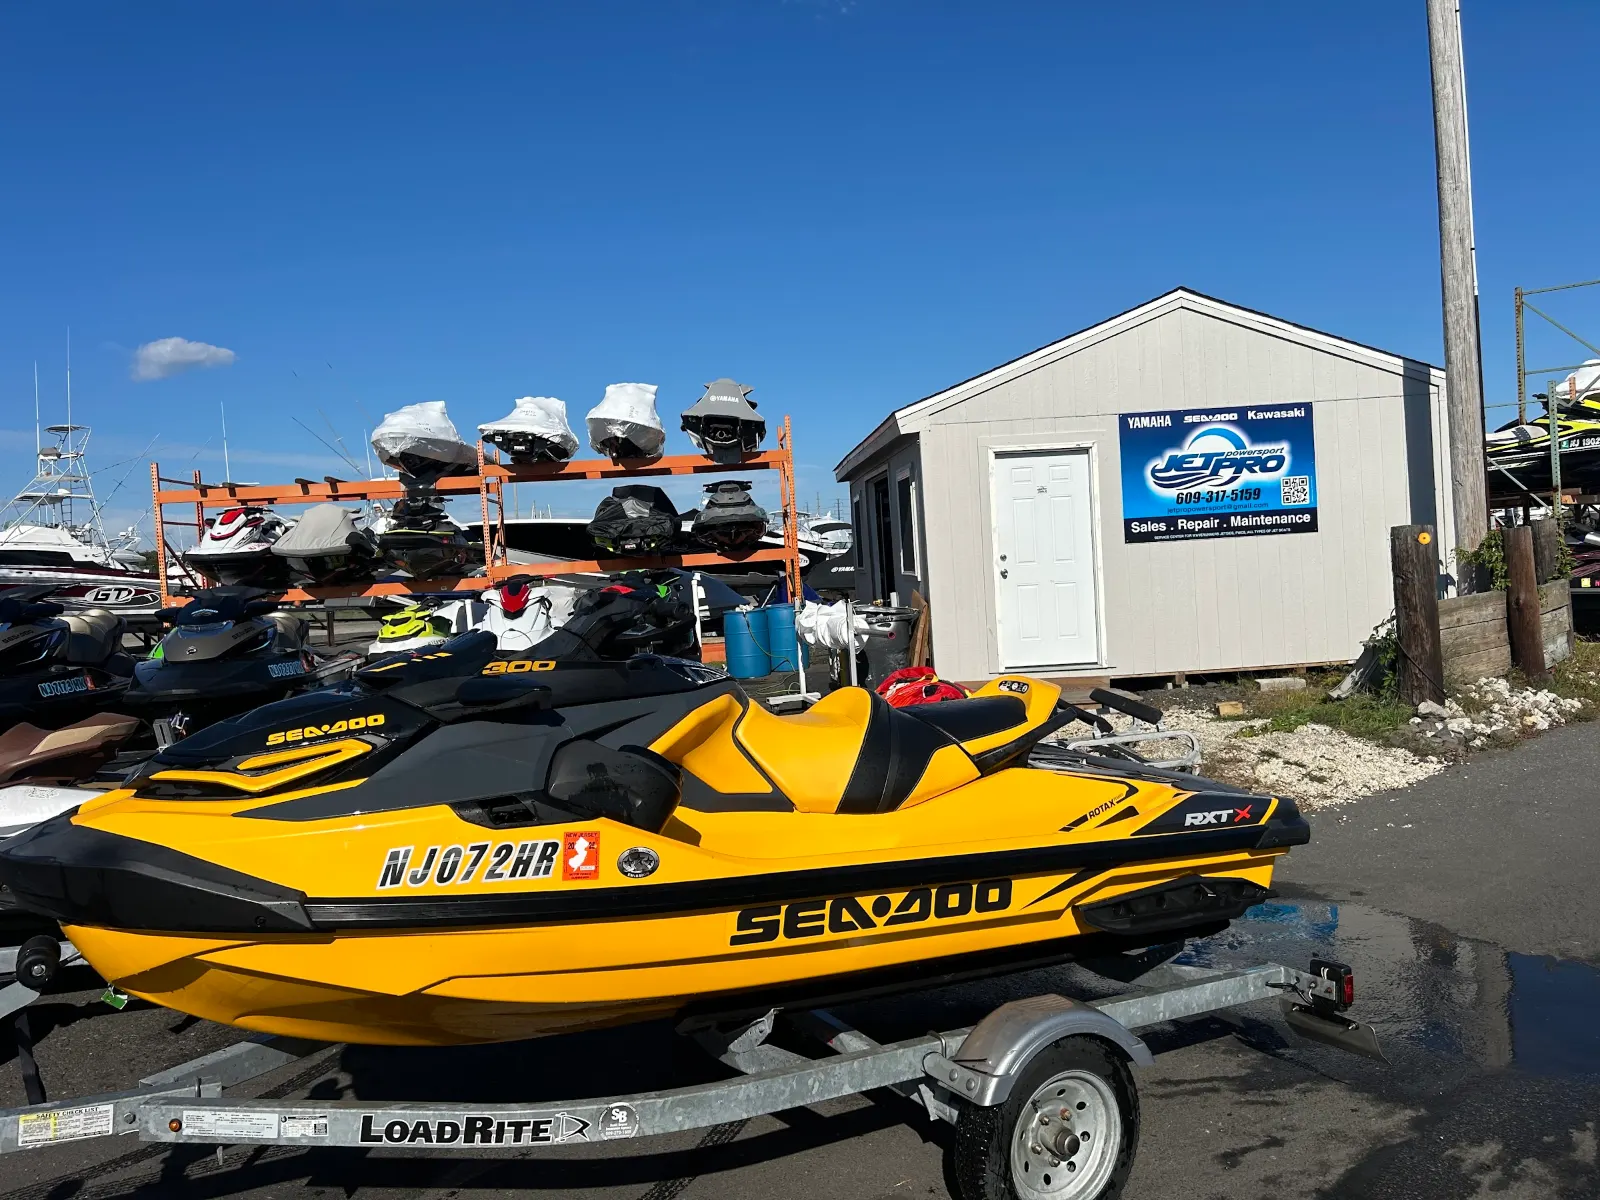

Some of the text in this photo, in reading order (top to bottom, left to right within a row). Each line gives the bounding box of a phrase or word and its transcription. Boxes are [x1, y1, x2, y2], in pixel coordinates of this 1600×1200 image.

[716, 395, 740, 403] YAMAHA
[1128, 415, 1172, 429] YAMAHA
[1247, 408, 1305, 420] Kawasaki
[1225, 447, 1285, 458] powersport
[1176, 488, 1261, 505] 609-317-5159
[1167, 503, 1269, 514] jetpropowersport@gmail.com
[1131, 520, 1167, 533] Sales
[1178, 517, 1220, 531] Repair
[1230, 513, 1311, 527] Maintenance
[482, 660, 556, 676] 300
[1088, 799, 1116, 820] ROTAX
[611, 1108, 628, 1123] SB
